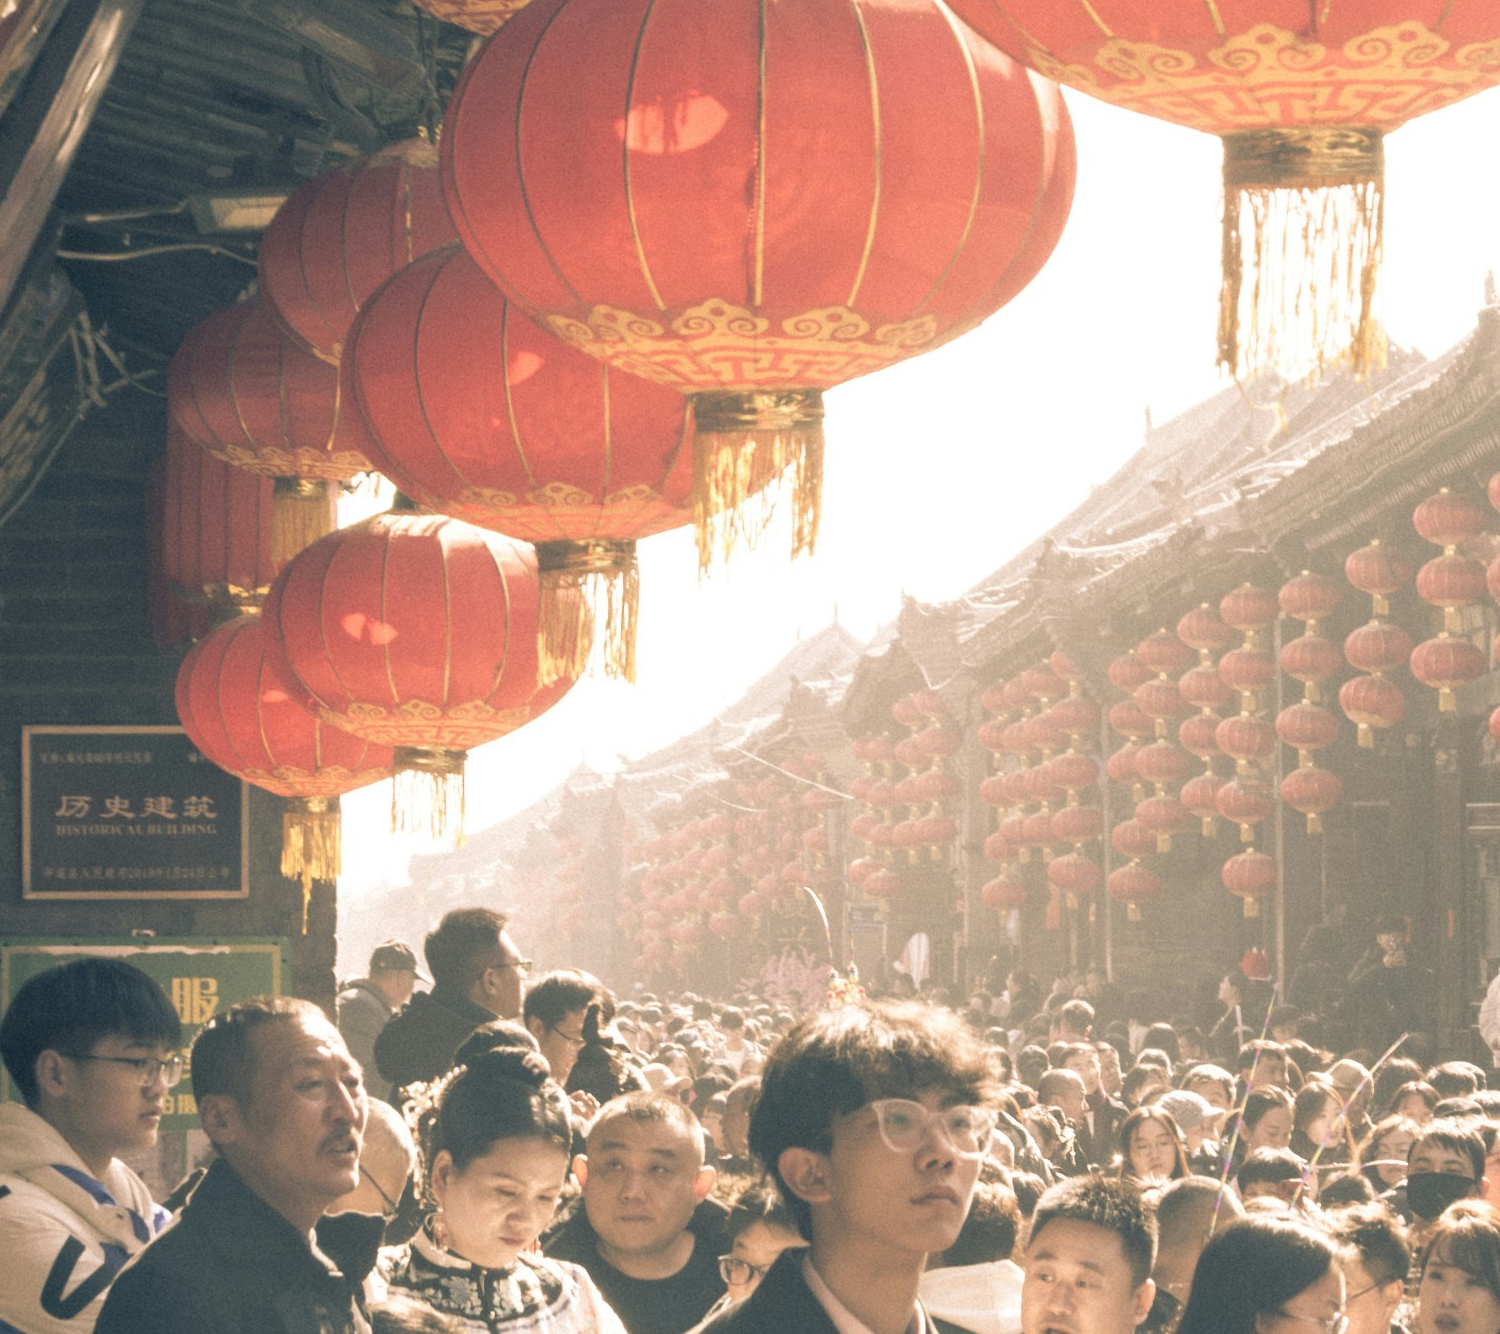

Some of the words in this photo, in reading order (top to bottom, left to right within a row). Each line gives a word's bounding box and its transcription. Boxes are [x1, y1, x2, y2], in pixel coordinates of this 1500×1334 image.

[55, 795, 218, 820] 历史建筑
[55, 824, 143, 836] HISTORICAL
[147, 824, 217, 836] BUILDING
[171, 976, 220, 1025] 服
